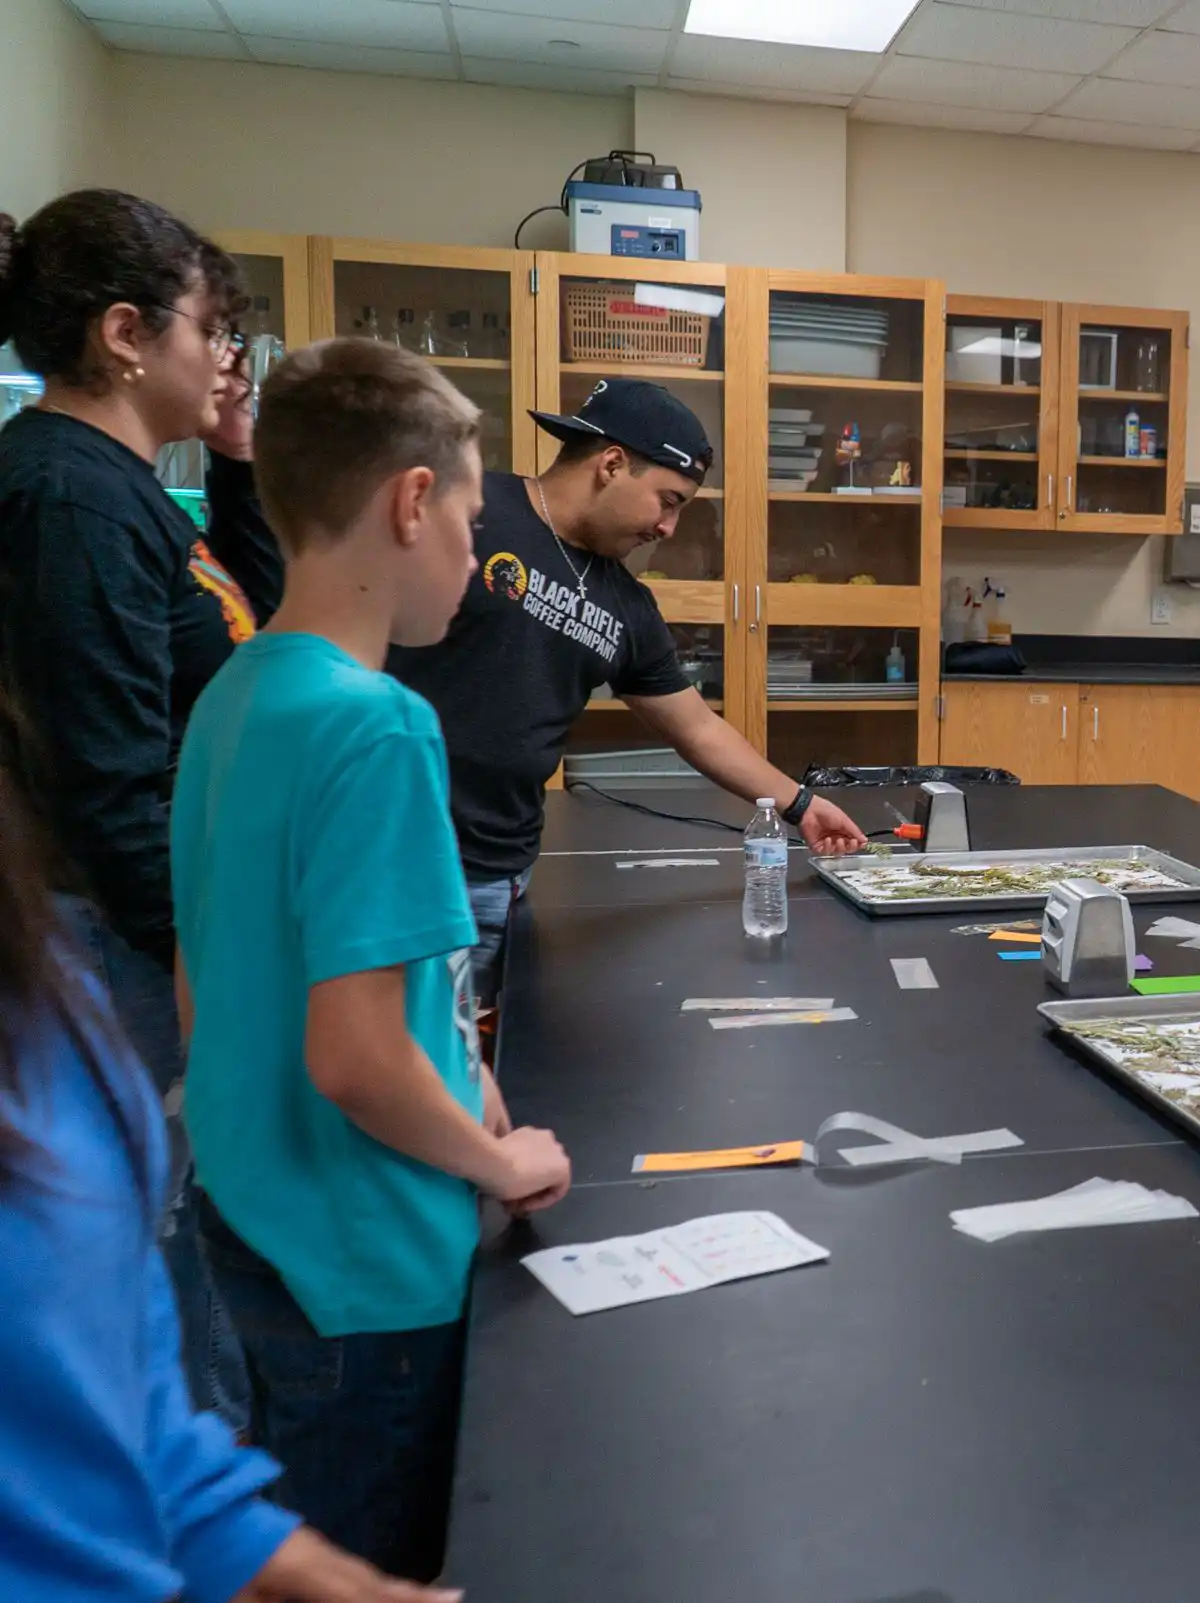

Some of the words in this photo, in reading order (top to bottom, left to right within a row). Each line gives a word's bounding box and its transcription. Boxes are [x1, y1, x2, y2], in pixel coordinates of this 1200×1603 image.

[523, 593, 564, 631] COFFEE
[563, 618, 617, 663] COMPANY
[528, 568, 580, 617] BLACK
[581, 600, 624, 646] RIFLE
